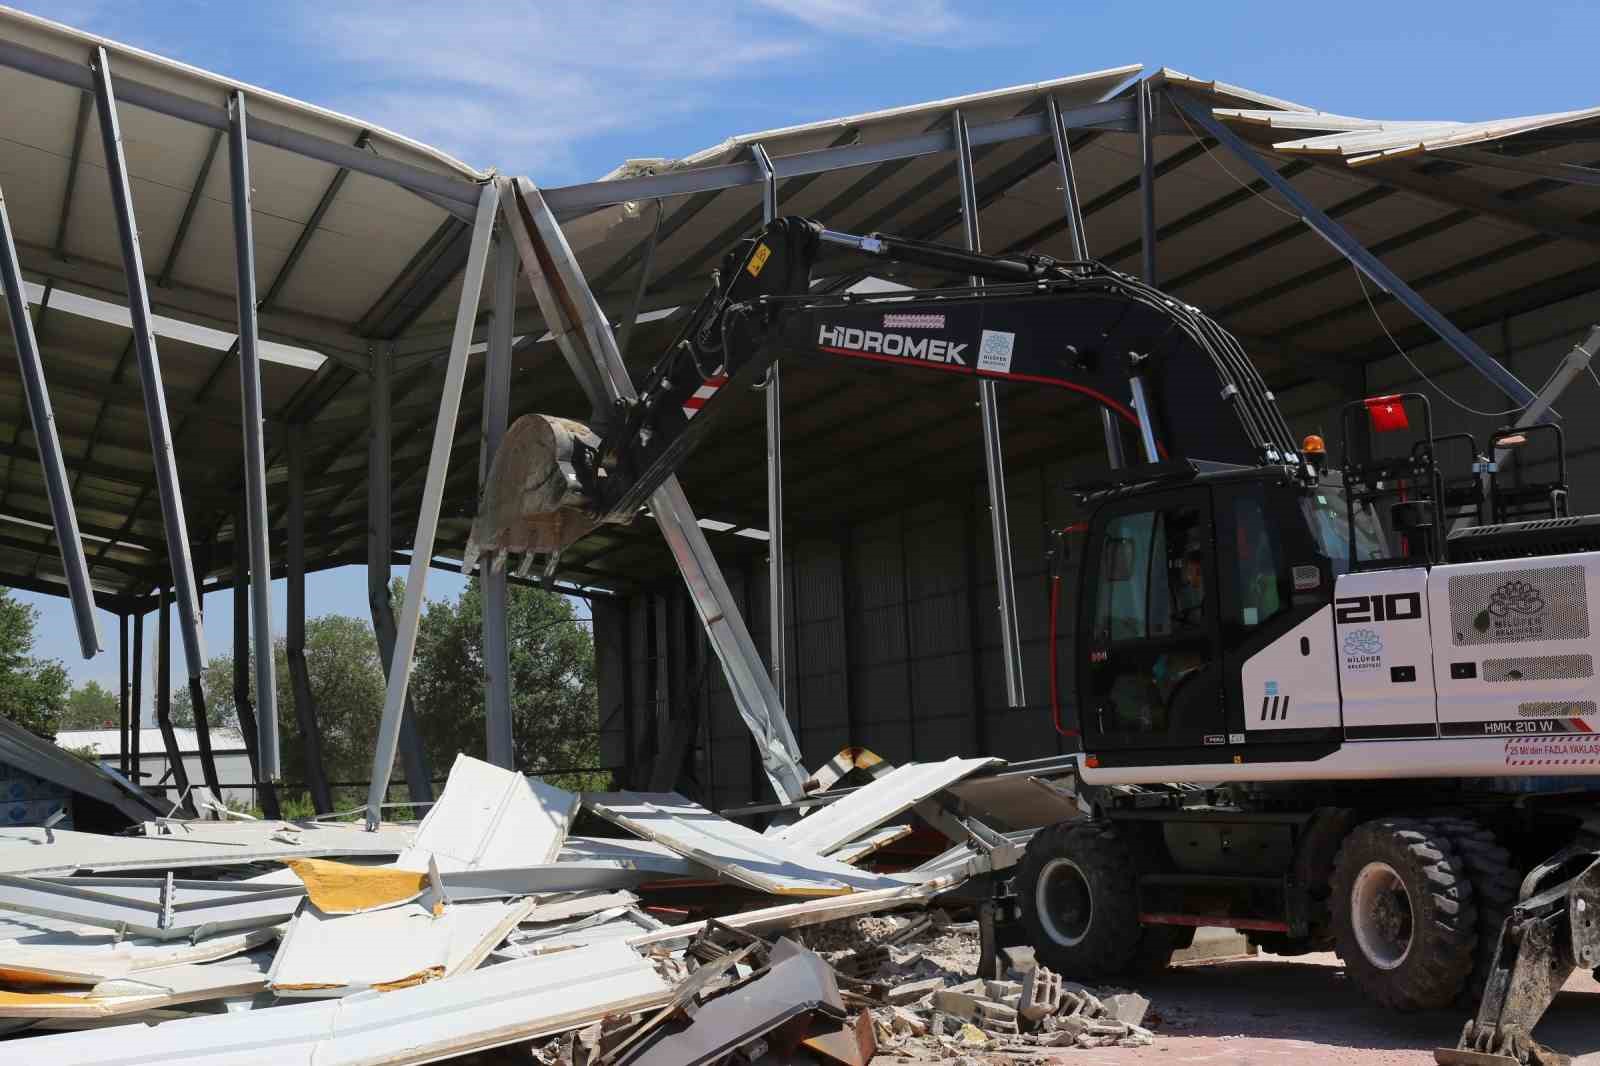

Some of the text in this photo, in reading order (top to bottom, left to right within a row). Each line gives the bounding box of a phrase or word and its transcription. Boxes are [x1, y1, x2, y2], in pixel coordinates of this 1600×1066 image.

[1336, 592, 1422, 624] 210
[1484, 720, 1554, 734] HMK 210 W
